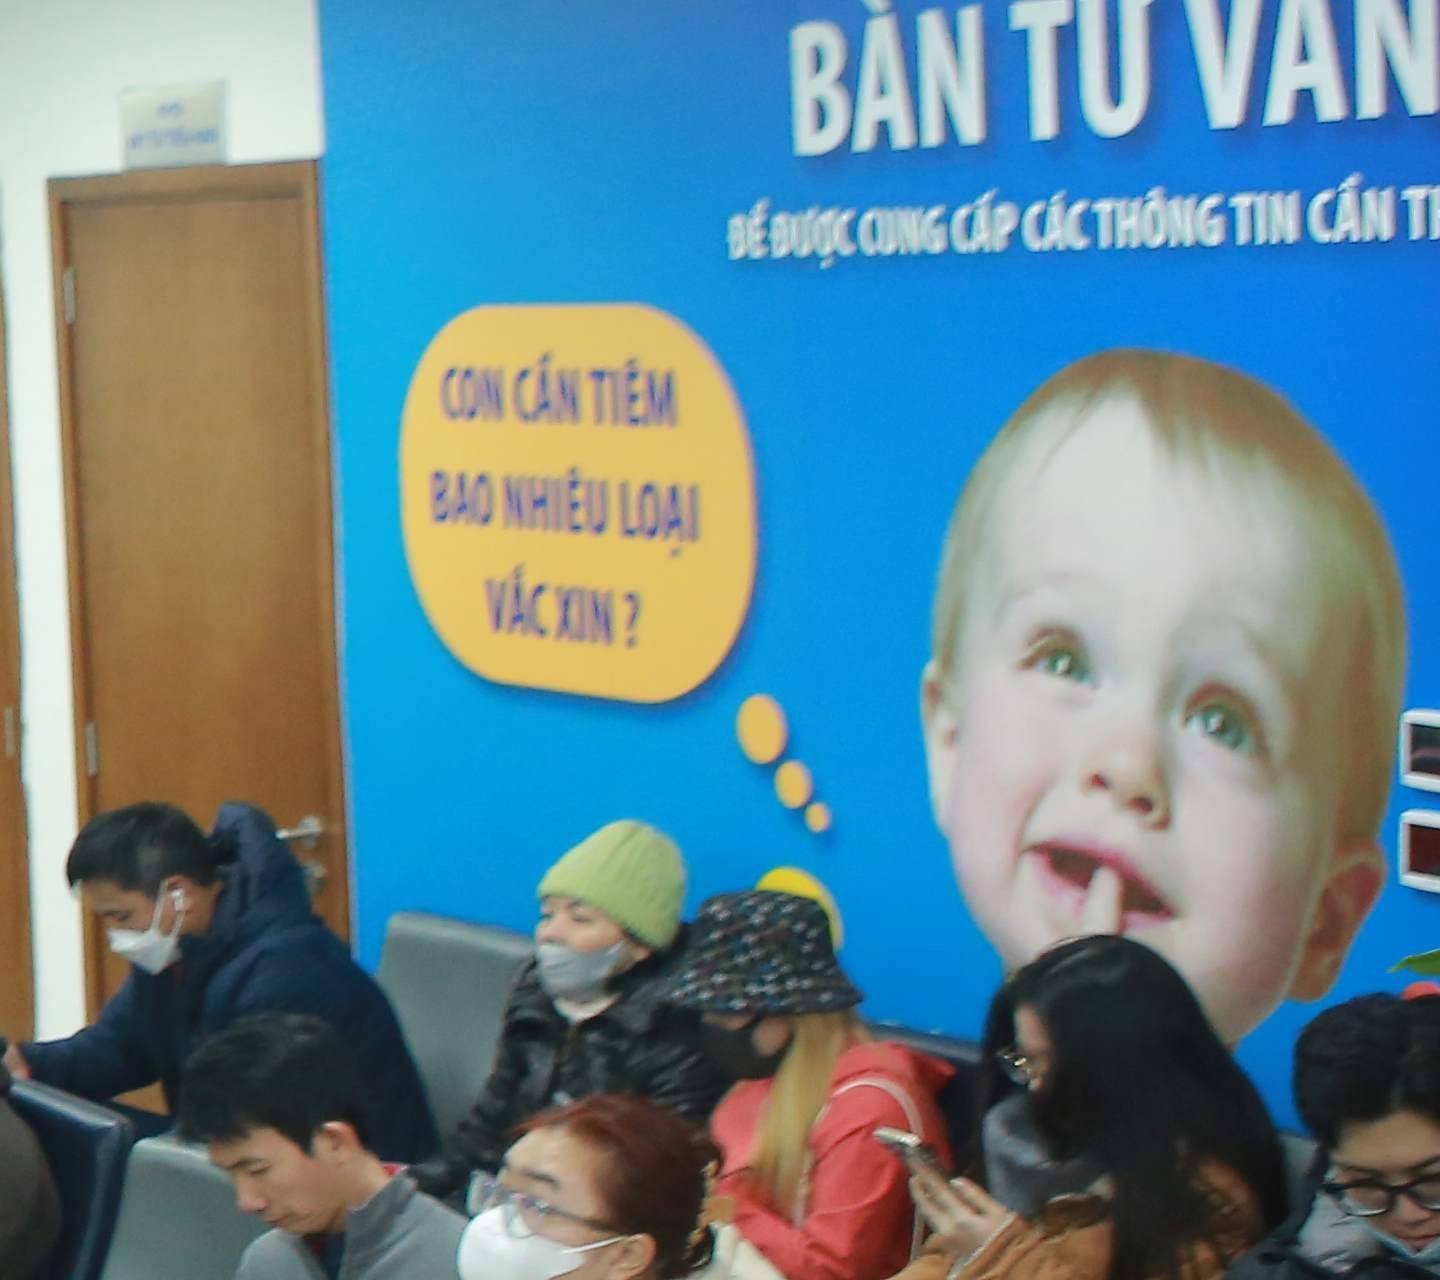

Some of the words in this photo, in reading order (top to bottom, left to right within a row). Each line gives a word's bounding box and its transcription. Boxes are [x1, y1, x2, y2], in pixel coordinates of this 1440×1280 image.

[857, 204, 949, 257] CUNG
[1020, 188, 1091, 253] CÁC
[1091, 185, 1227, 250] THÔNG
[1228, 189, 1302, 247] TIN
[440, 366, 505, 421] CON
[588, 356, 678, 427] TIÊM
[430, 469, 496, 527] BAO
[502, 465, 609, 535] NHIÊU
[618, 480, 701, 558] LOẠI
[554, 585, 615, 647] XIN
